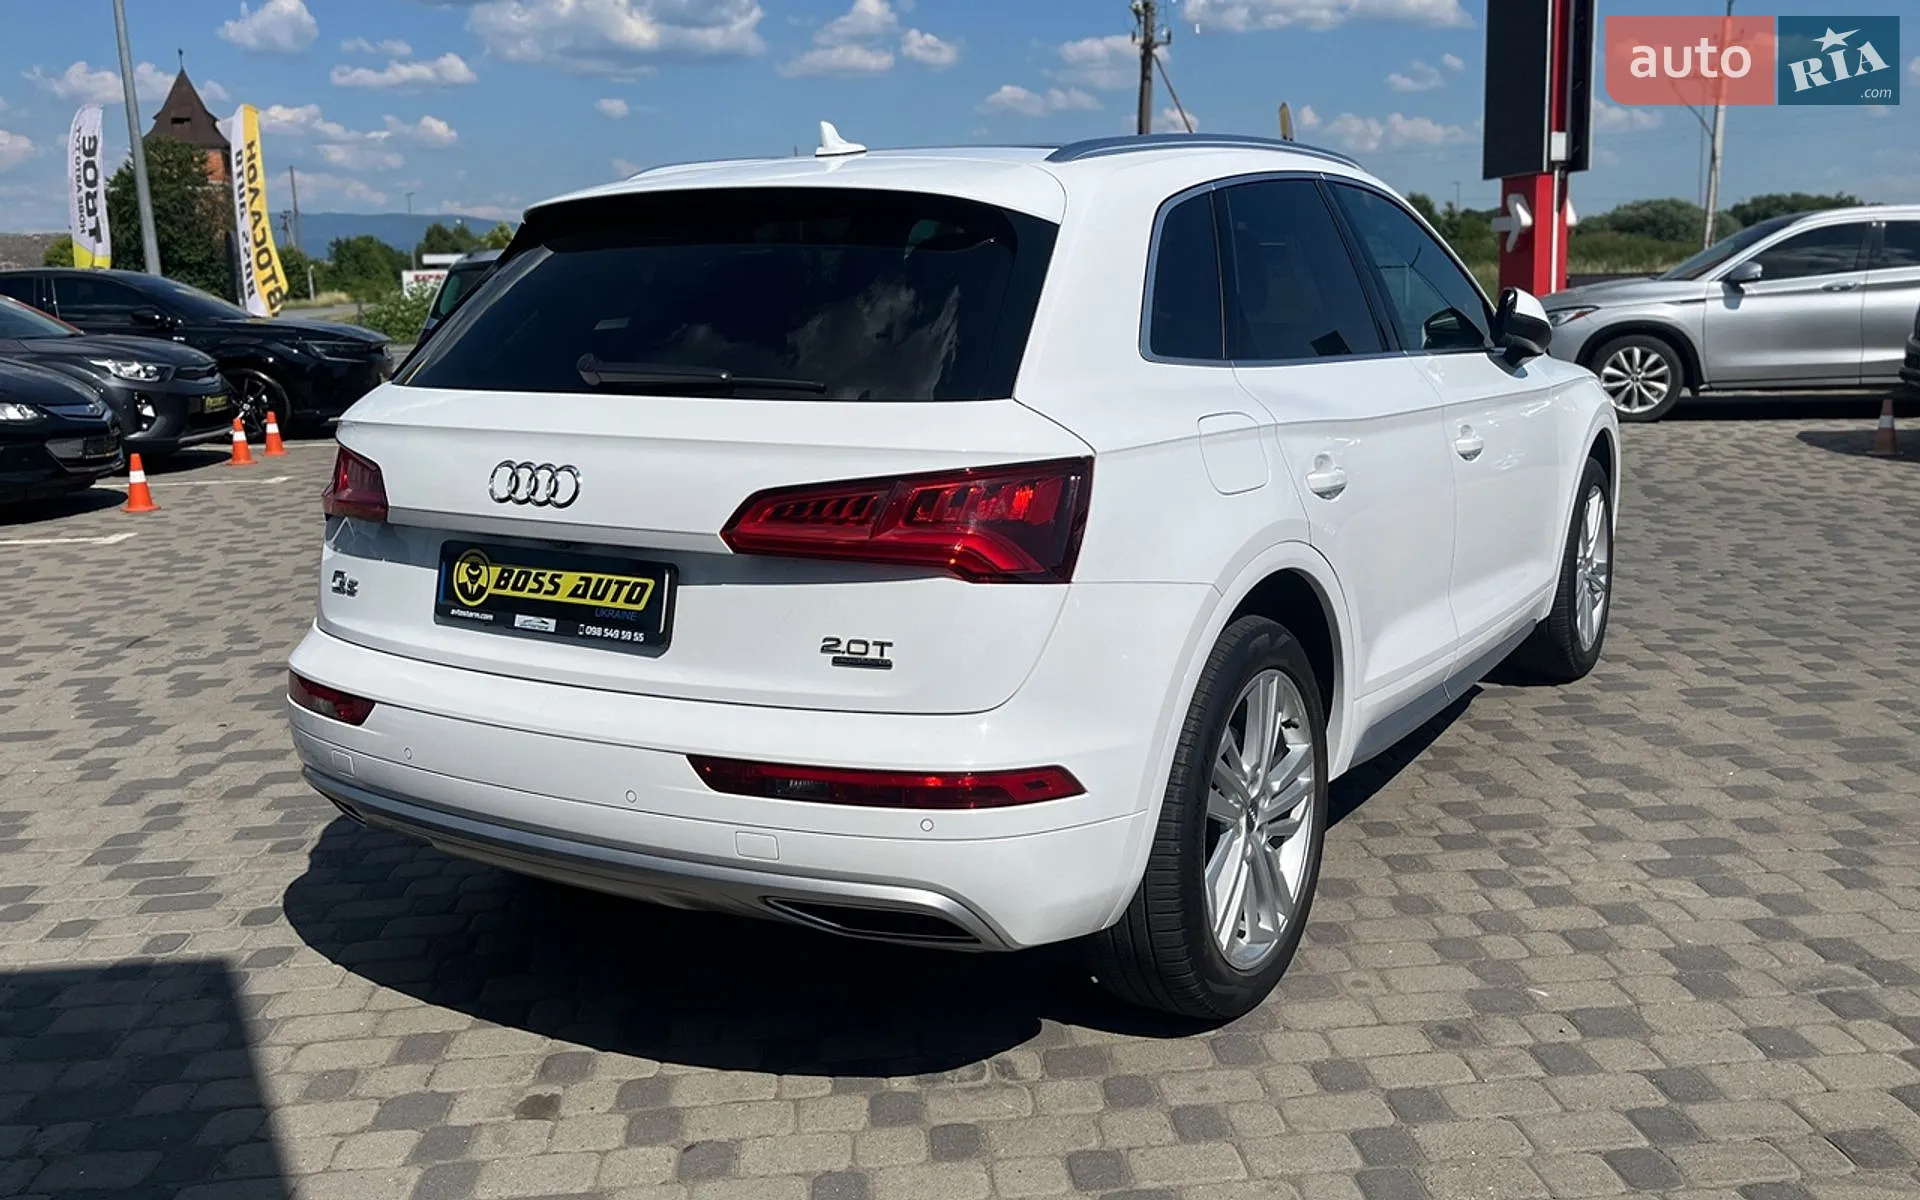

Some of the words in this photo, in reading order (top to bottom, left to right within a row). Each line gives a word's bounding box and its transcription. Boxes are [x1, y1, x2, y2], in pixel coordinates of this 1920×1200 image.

[494, 568, 563, 596] BOSS
[567, 576, 649, 605] AUTO
[595, 607, 638, 621] UKRAINE
[820, 637, 893, 657] 2.0T
